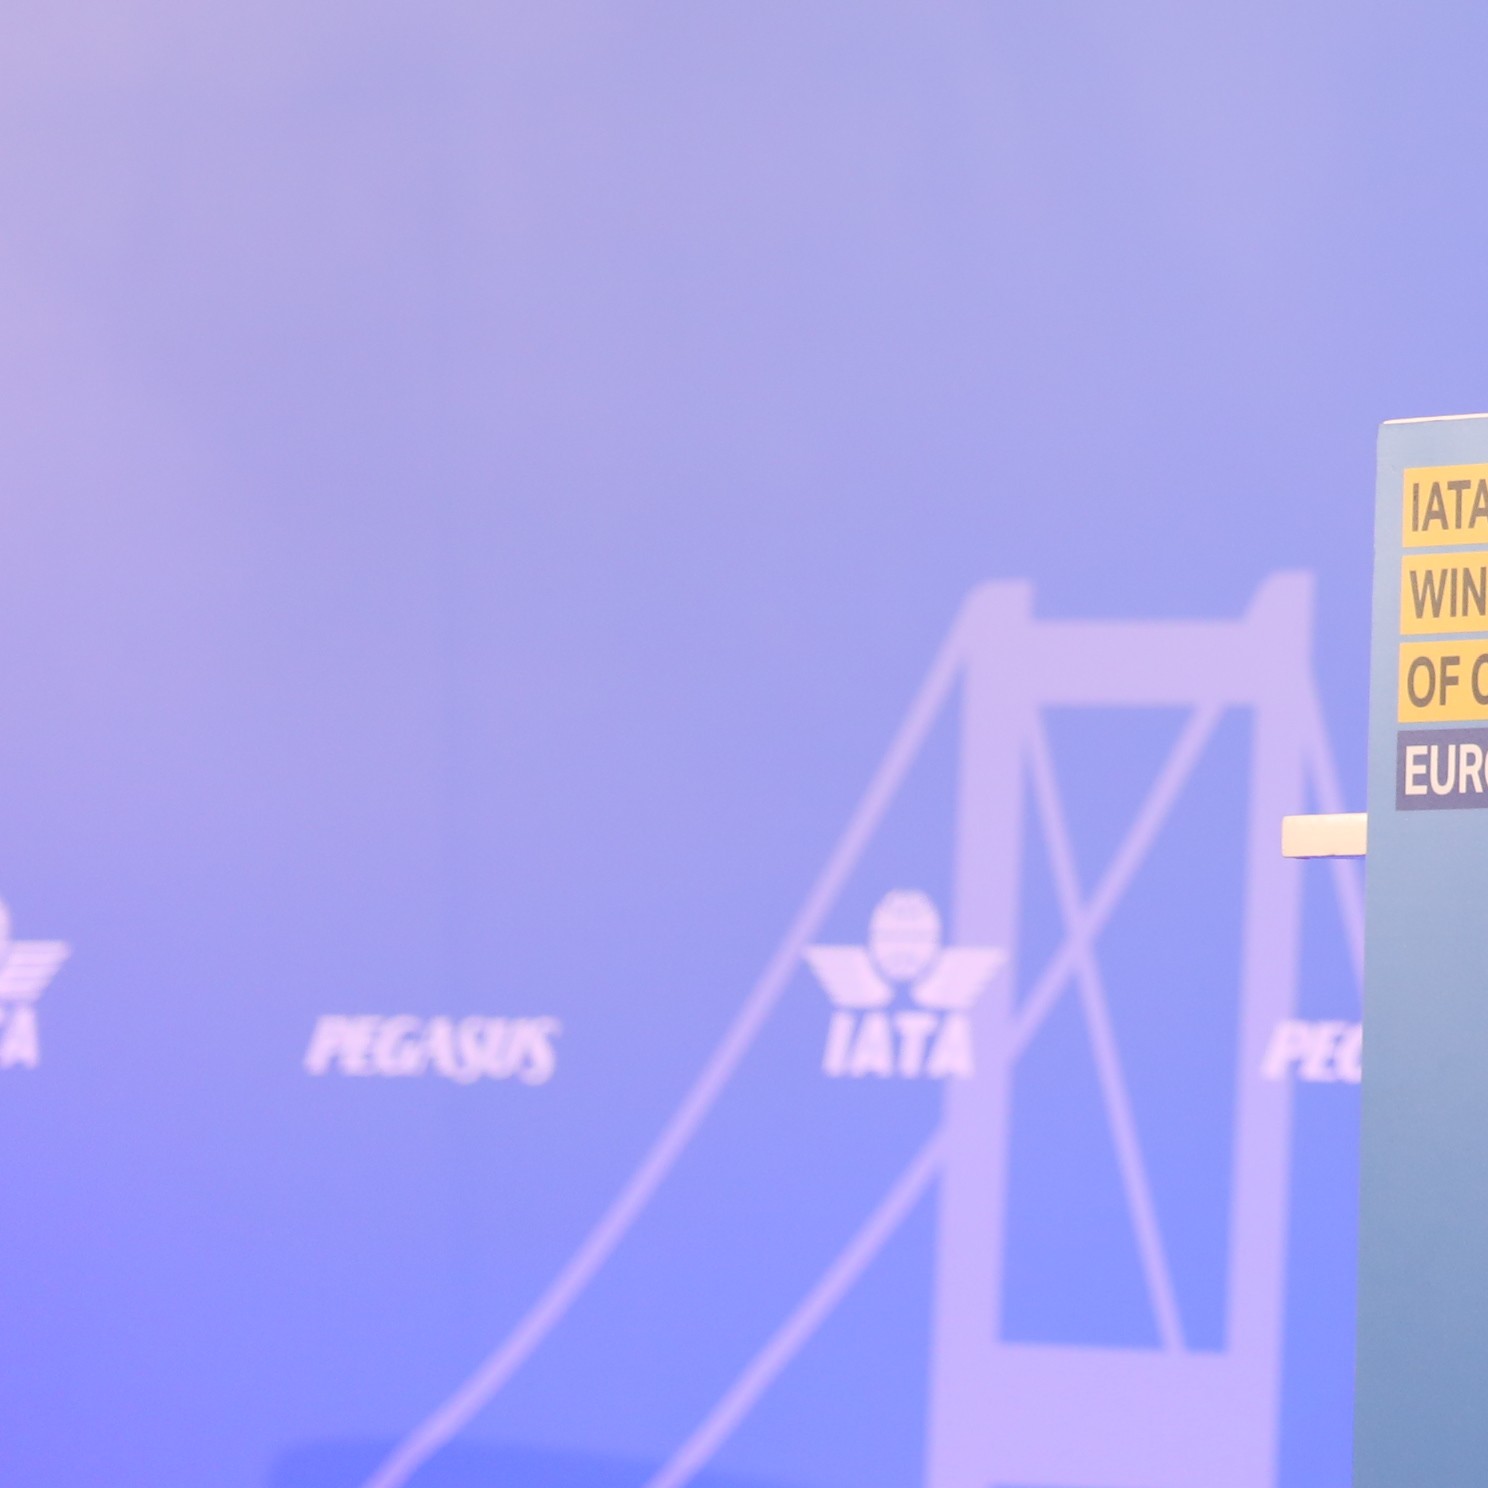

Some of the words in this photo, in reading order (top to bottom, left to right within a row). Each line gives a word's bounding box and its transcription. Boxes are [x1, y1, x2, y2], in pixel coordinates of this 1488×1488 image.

[1407, 655, 1461, 708] OF
[304, 1014, 562, 1085] PEGASUS
[822, 1010, 975, 1080] IATA
